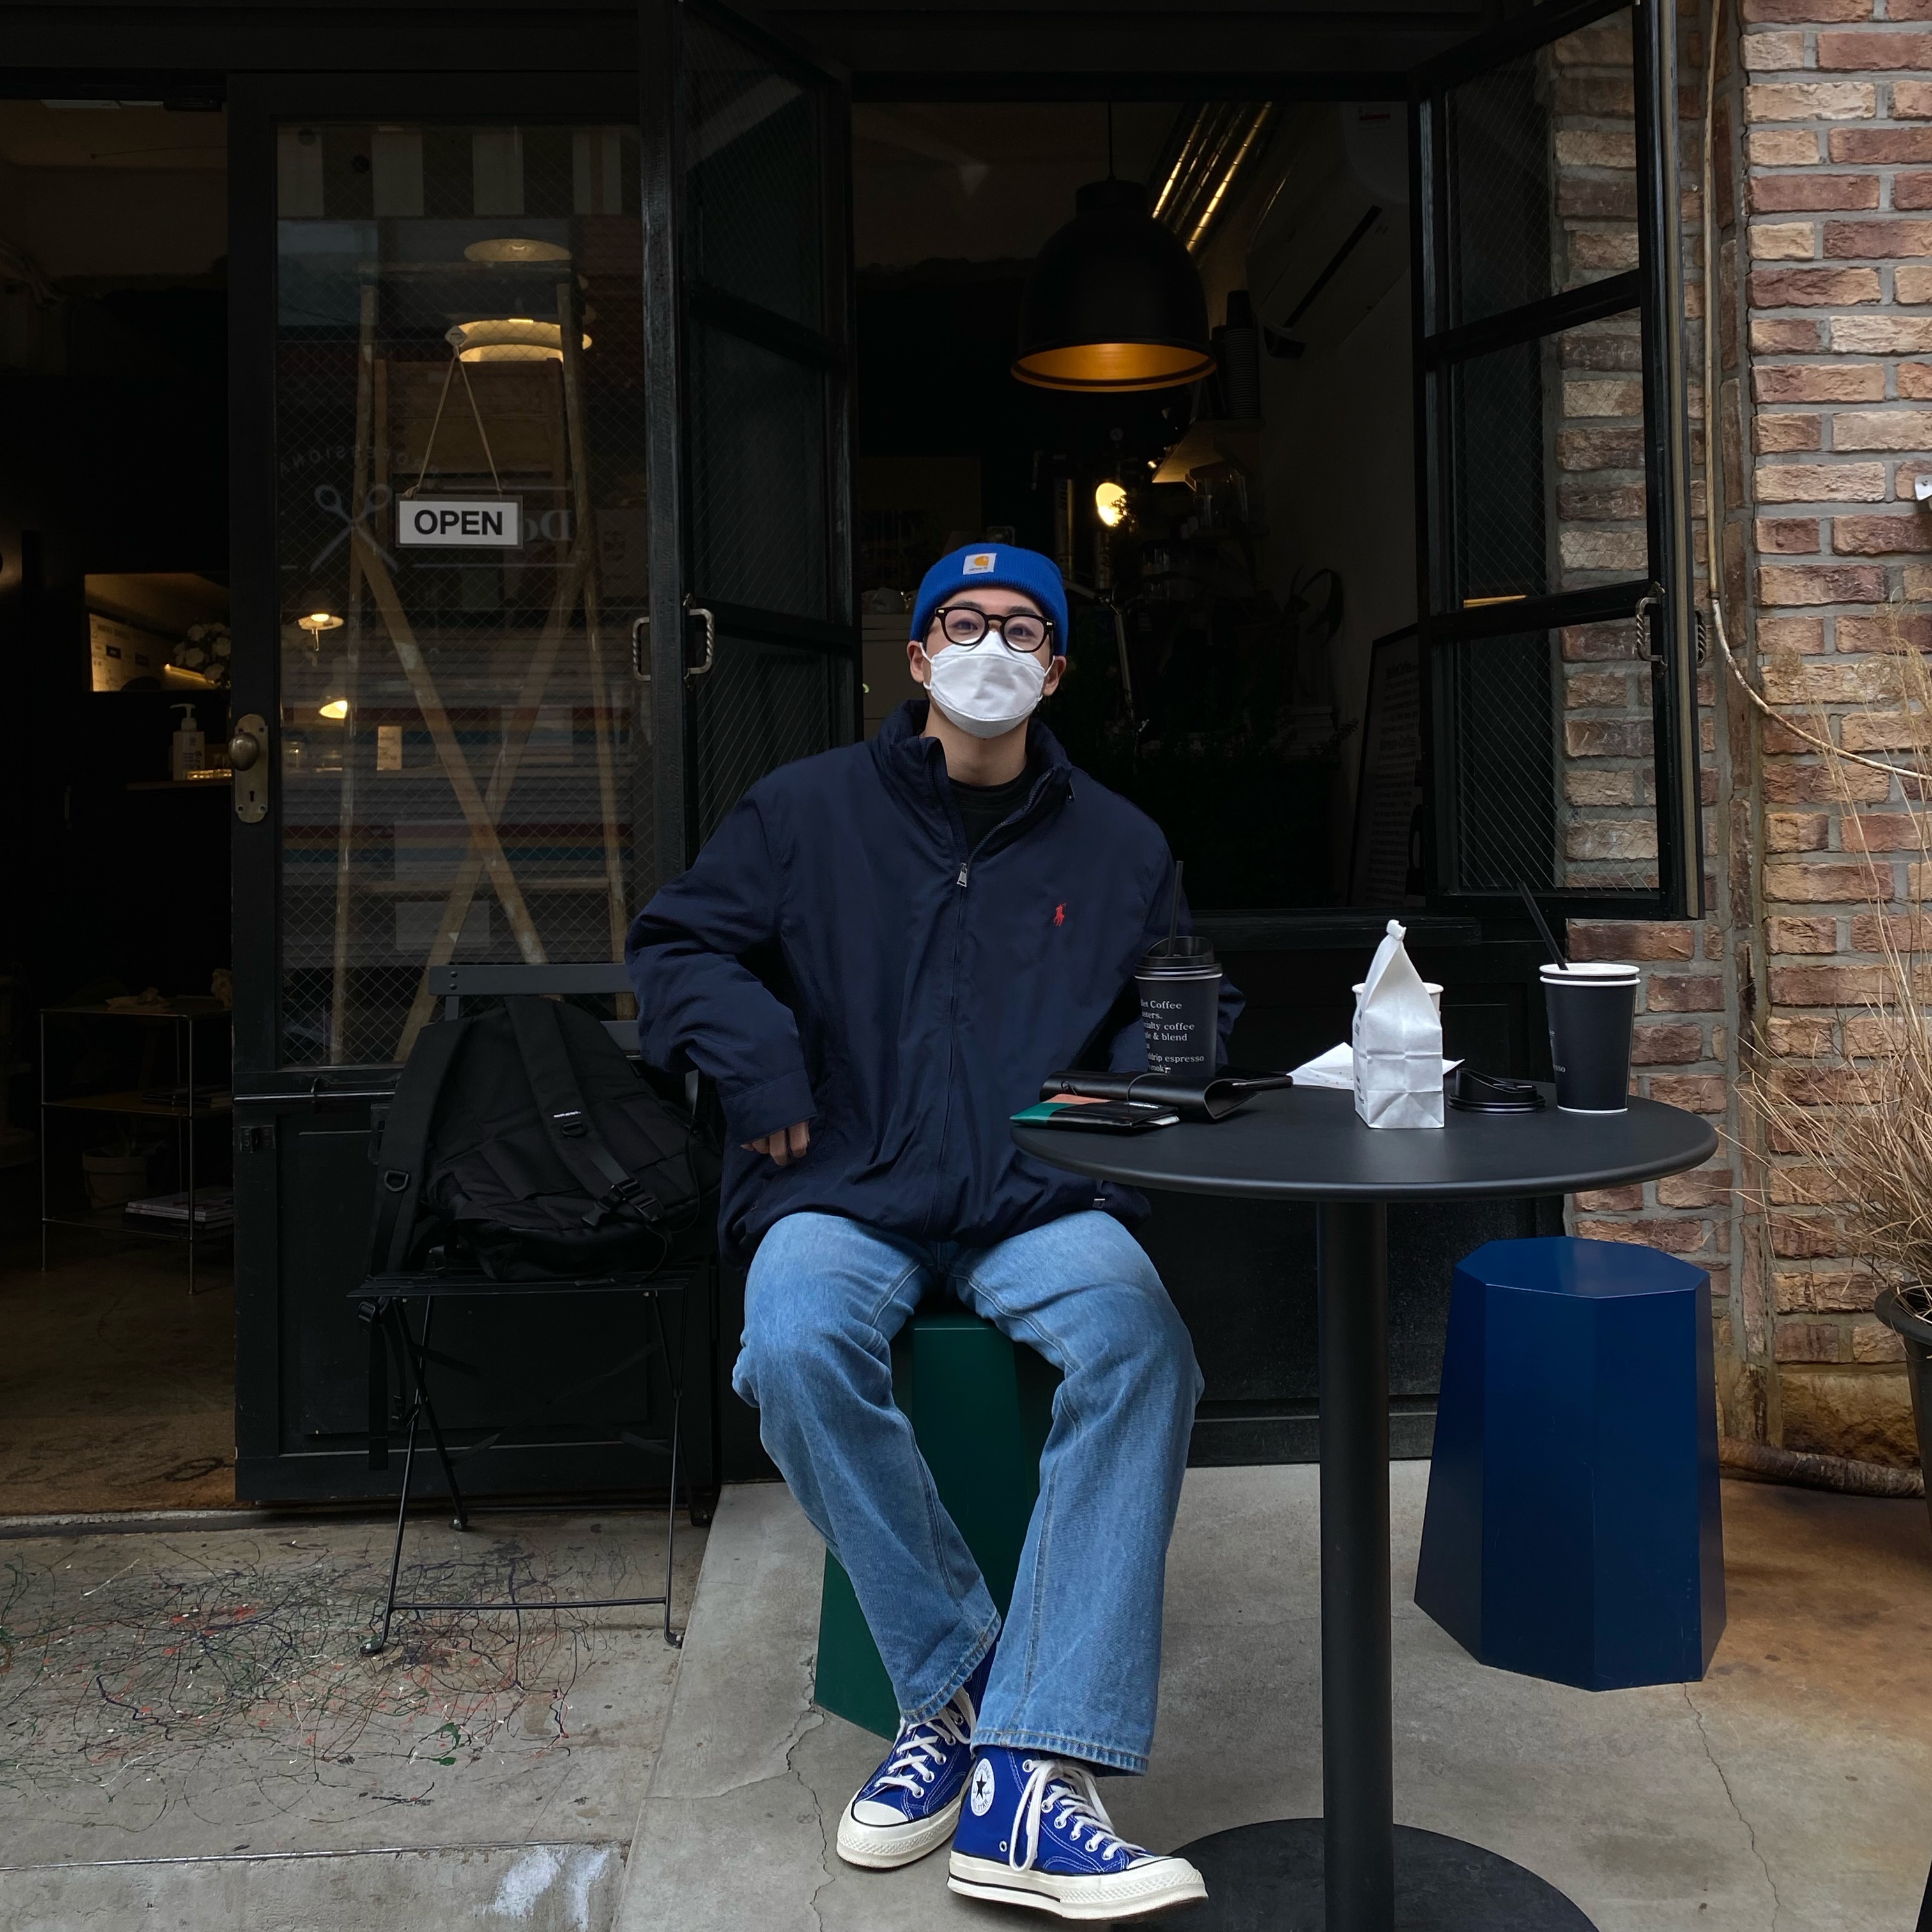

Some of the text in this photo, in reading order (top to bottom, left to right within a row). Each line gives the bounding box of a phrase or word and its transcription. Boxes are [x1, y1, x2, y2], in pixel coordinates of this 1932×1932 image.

[414, 509, 503, 535] OPEN
[1150, 1000, 1182, 1009] Coffee
[1153, 1032, 1159, 1040] &
[1162, 1032, 1188, 1041] blend
[1165, 1055, 1204, 1064] espresso
